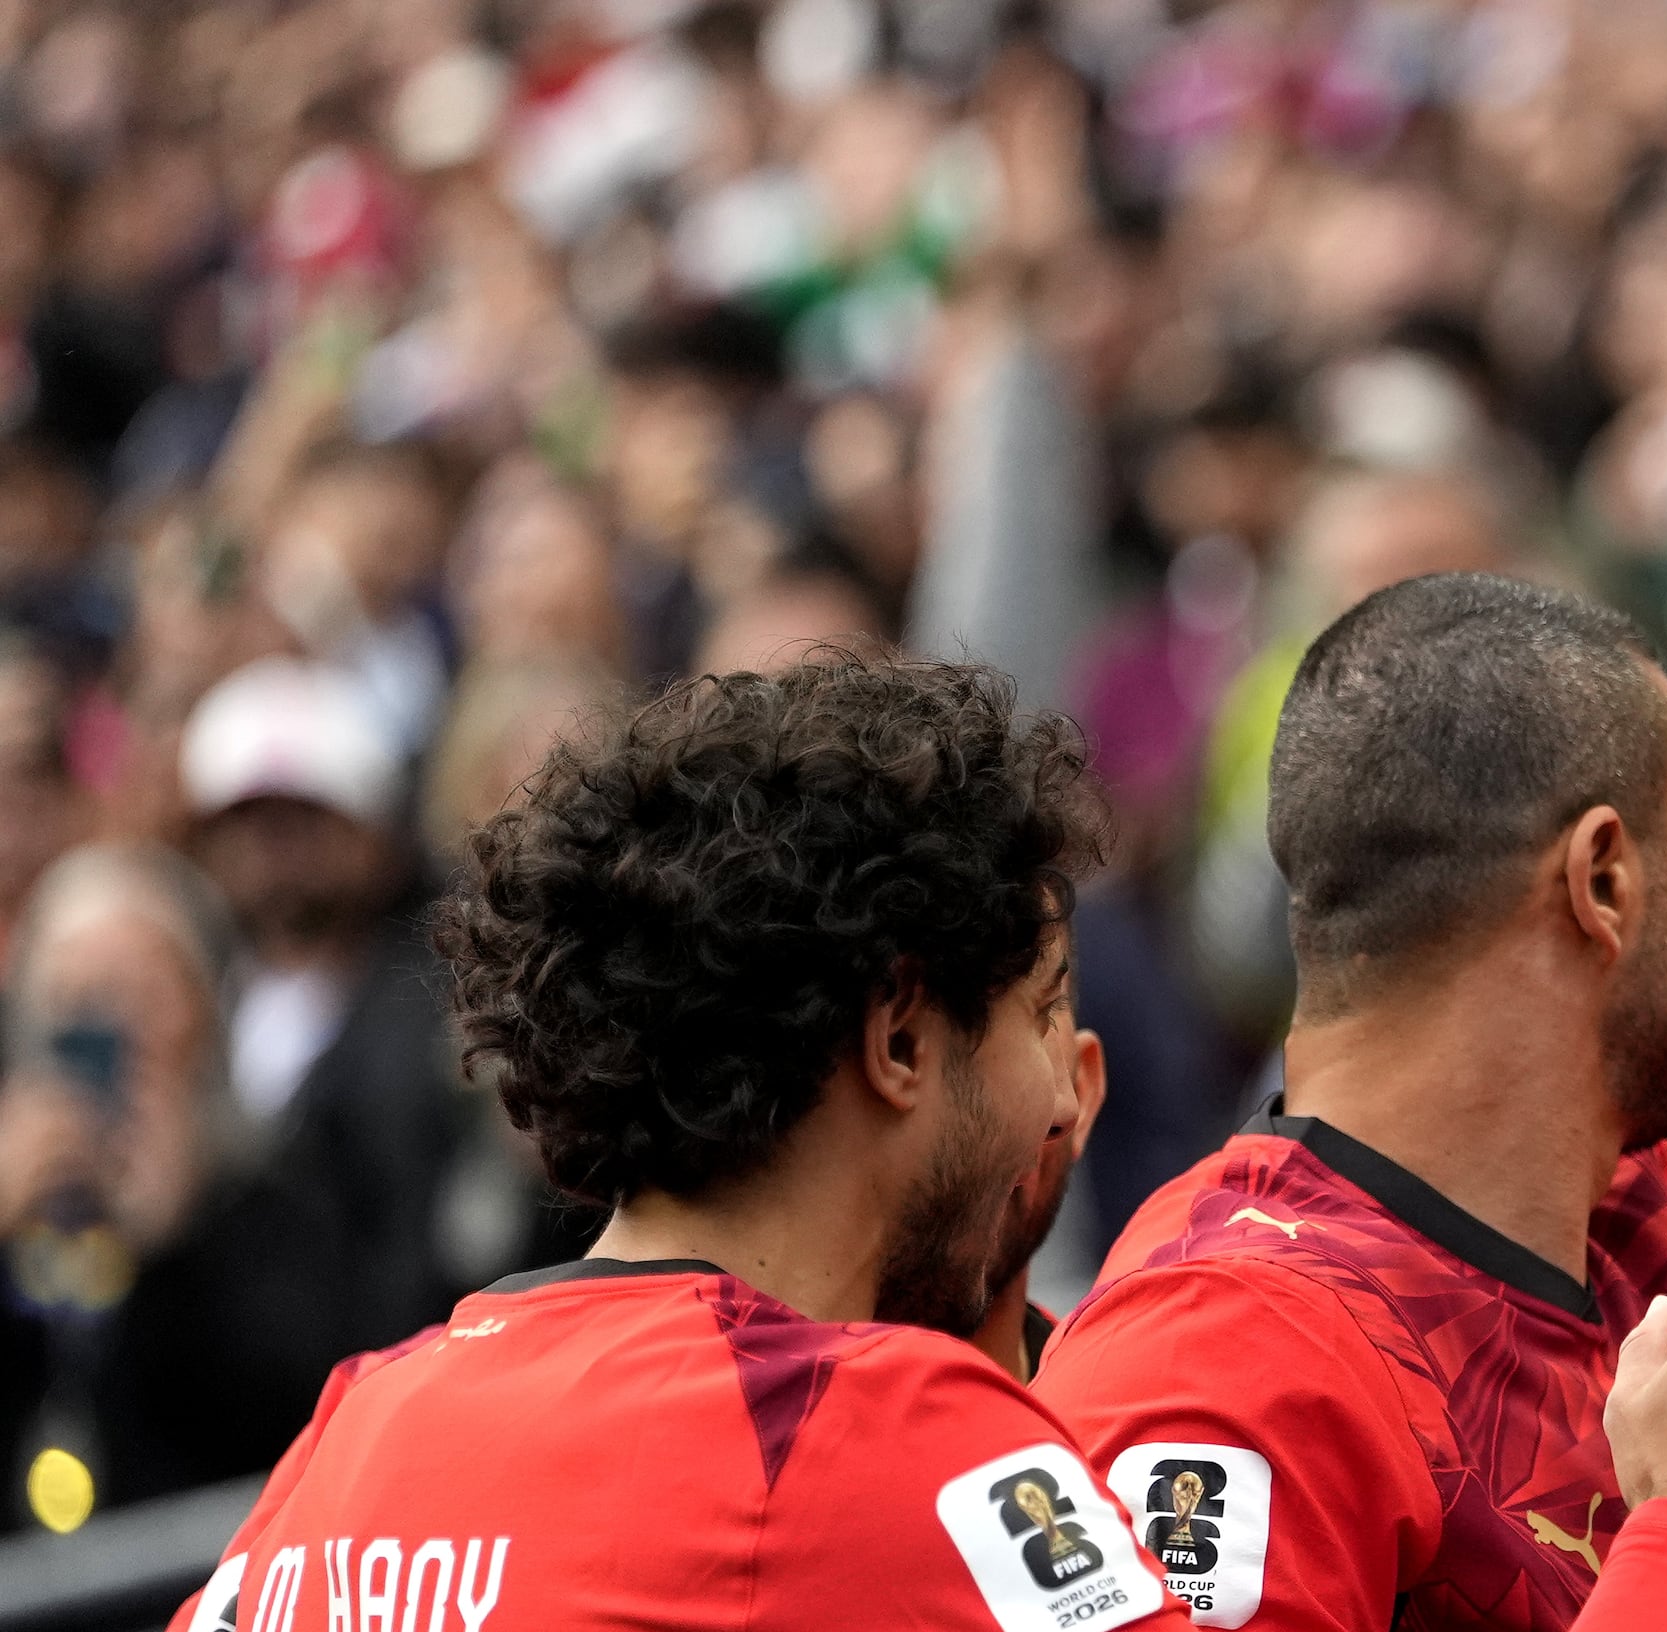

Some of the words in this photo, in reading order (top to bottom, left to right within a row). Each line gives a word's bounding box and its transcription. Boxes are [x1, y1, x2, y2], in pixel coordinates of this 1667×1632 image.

[1052, 1552, 1091, 1579] FIFA
[1162, 1550, 1198, 1565] FIFA
[1047, 1584, 1096, 1613] WORLD
[1097, 1575, 1117, 1589] CUP
[1189, 1580, 1216, 1591] CUP
[1056, 1589, 1129, 1629] 2026
